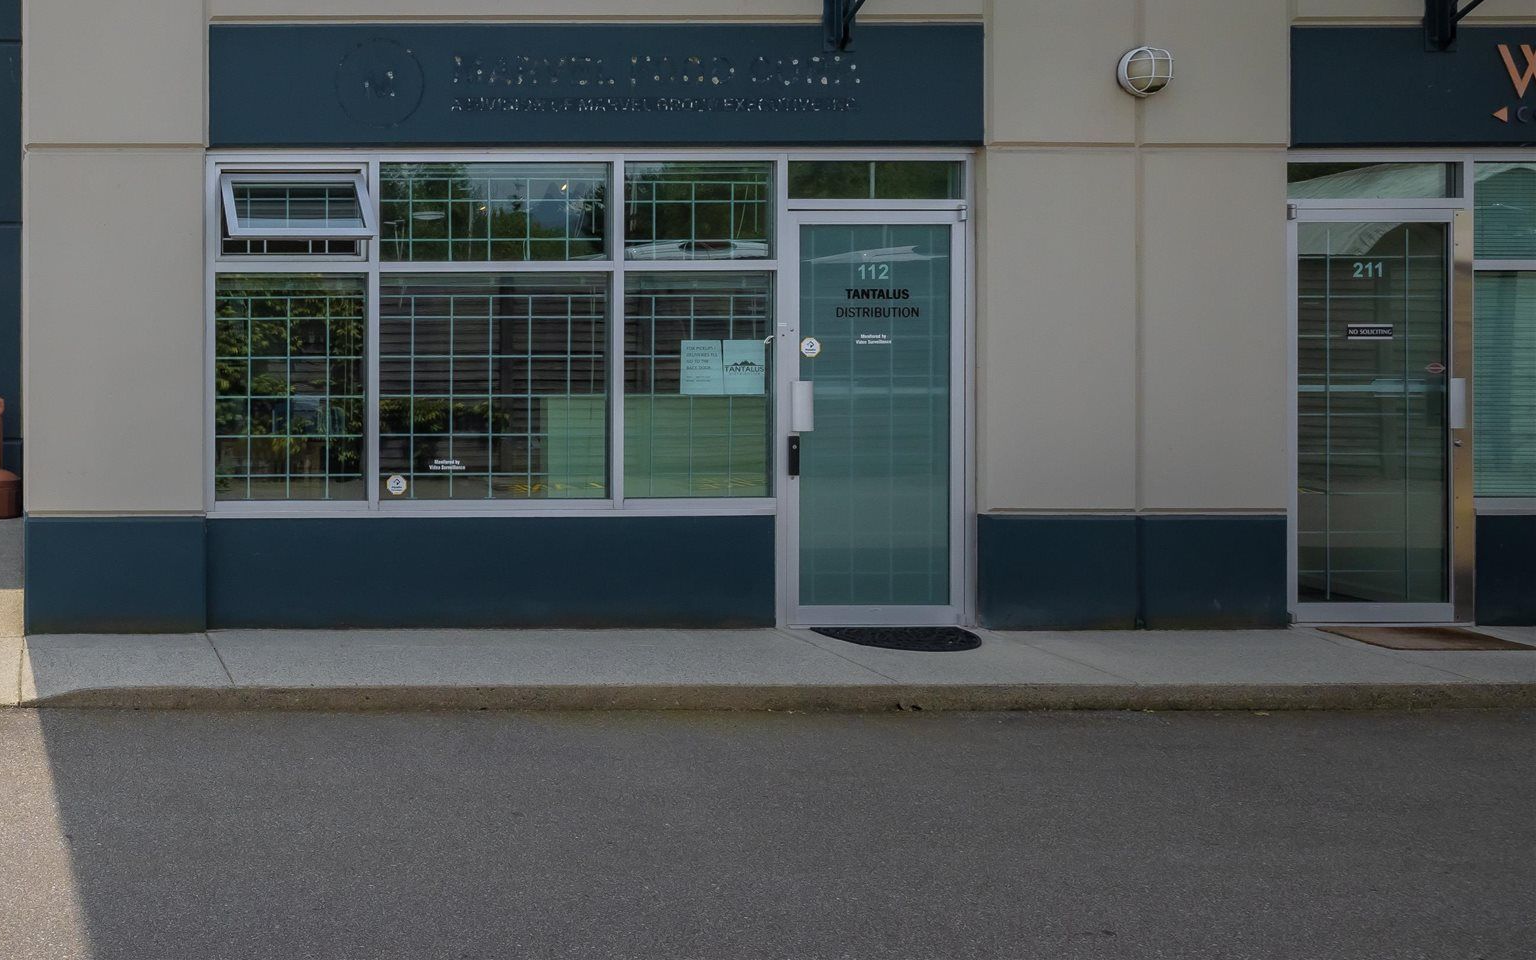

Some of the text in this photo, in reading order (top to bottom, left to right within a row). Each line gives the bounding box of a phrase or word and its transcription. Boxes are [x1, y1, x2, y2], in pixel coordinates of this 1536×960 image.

[857, 264, 889, 280] 112
[1352, 262, 1383, 278] 211
[845, 288, 910, 300] TANTALUS
[835, 306, 920, 318] DISTRIBUTION
